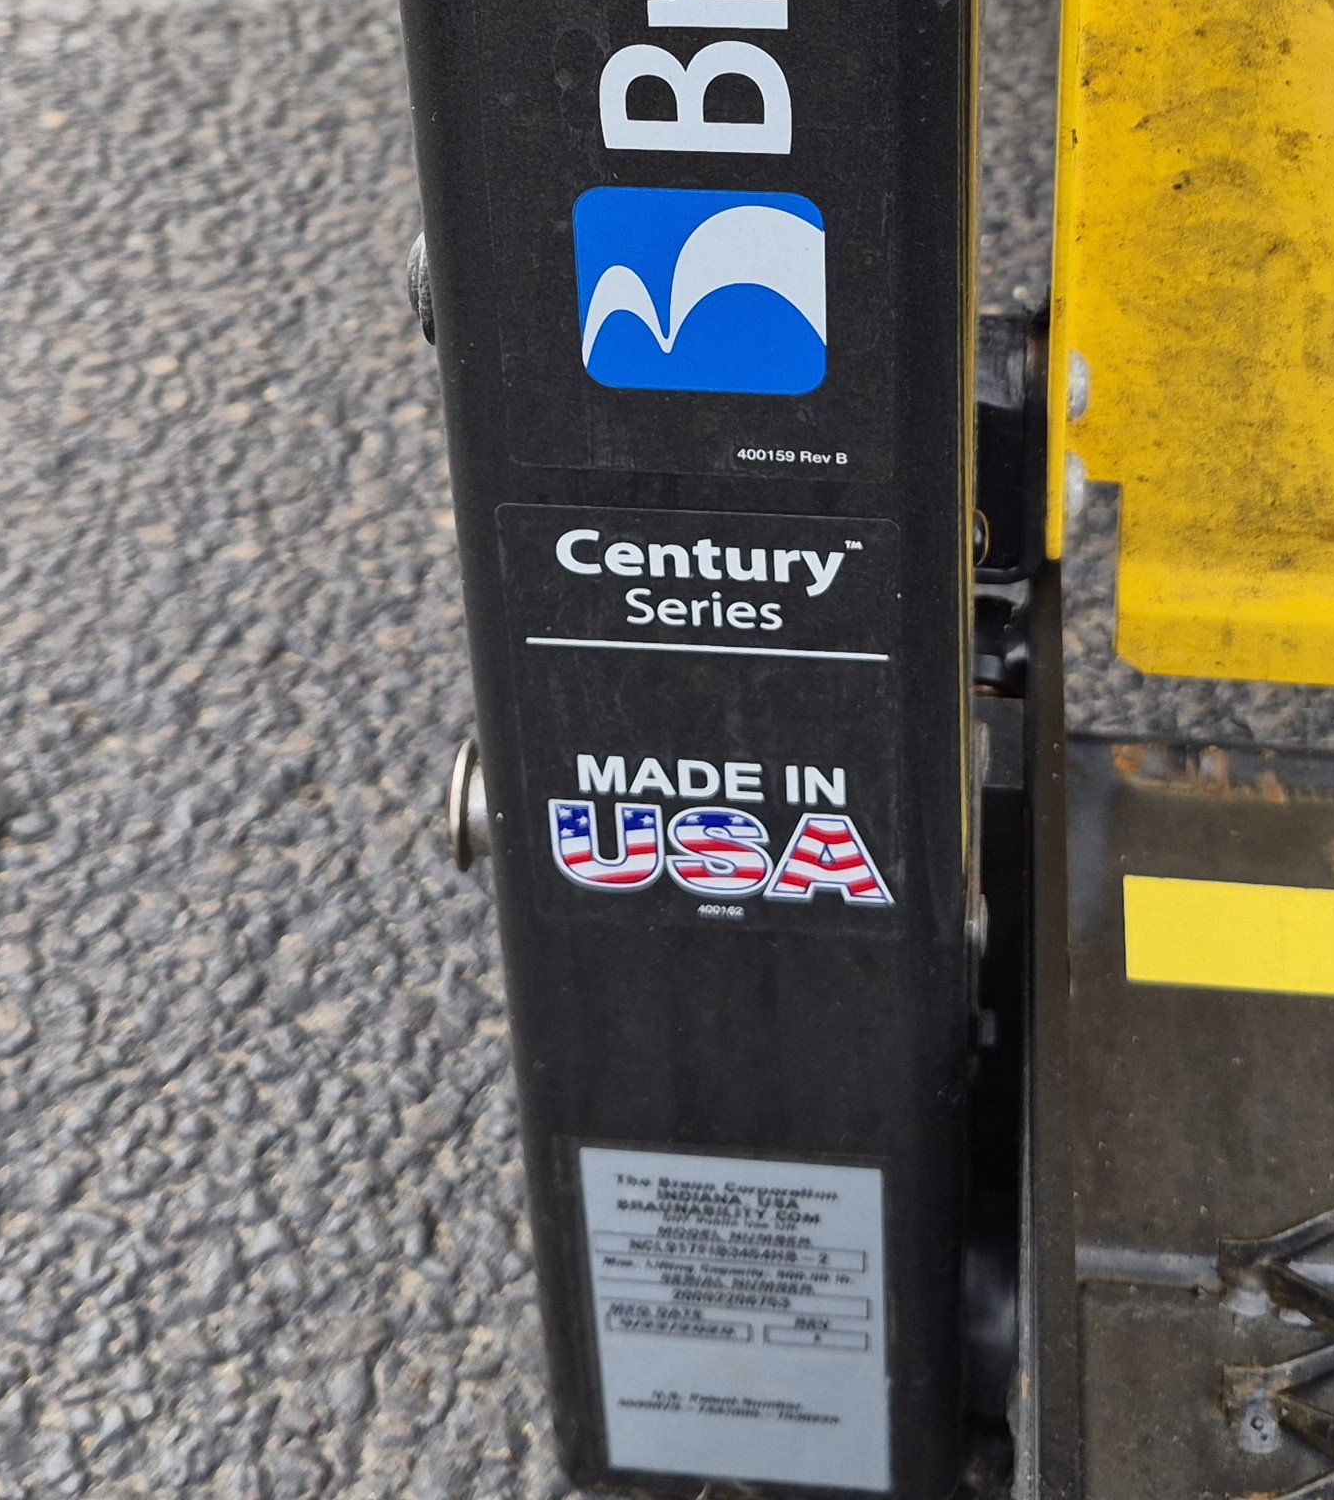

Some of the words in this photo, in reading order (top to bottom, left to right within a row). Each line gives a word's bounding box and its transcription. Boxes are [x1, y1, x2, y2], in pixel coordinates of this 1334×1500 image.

[736, 447, 795, 463] 400159
[799, 449, 834, 464] Rev
[836, 451, 848, 465] B
[624, 587, 784, 631] Series
[577, 754, 764, 802] MADE
[785, 765, 847, 806] IN
[548, 798, 896, 907] USA
[616, 1173, 652, 1187] The
[658, 1177, 716, 1193] Braun
[724, 1181, 839, 1201] Corporation
